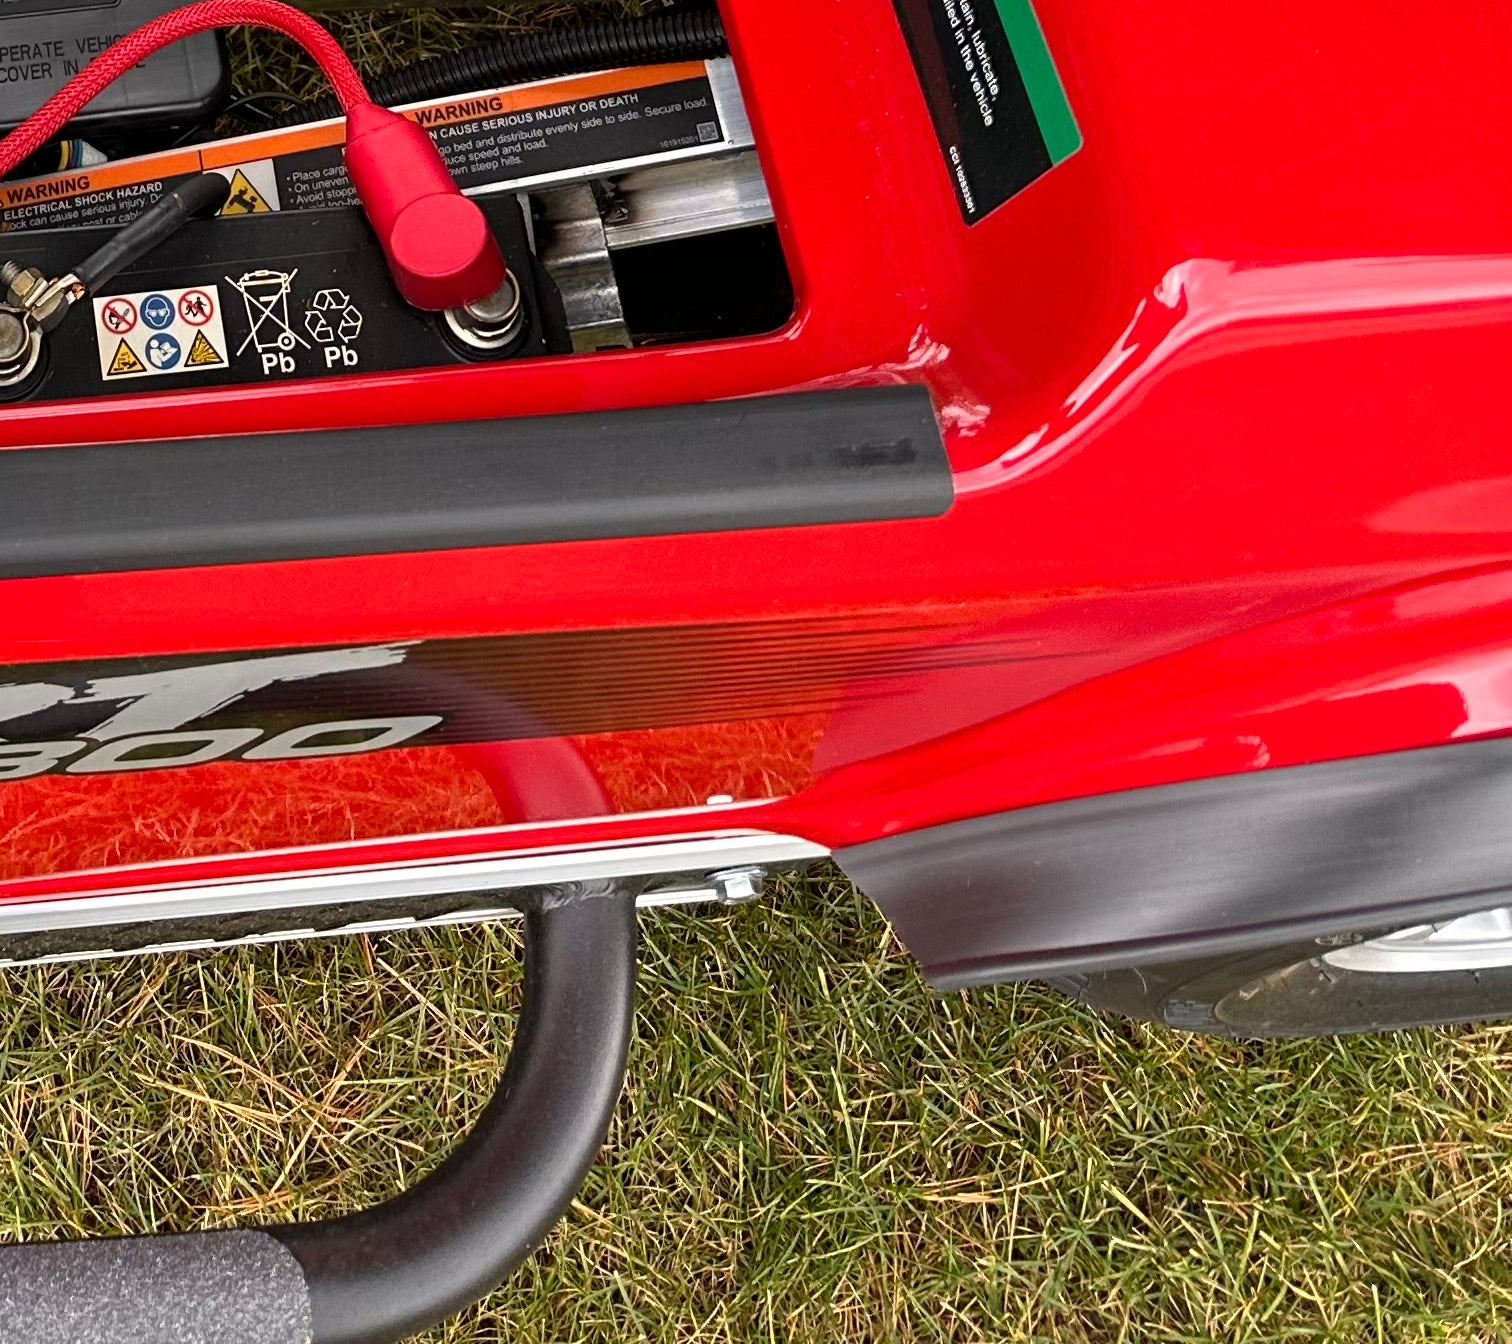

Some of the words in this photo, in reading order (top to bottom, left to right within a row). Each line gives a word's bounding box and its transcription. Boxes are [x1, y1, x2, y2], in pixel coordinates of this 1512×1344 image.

[75, 32, 126, 54] VEHIC
[954, 27, 965, 45] in
[960, 44, 974, 71] the
[970, 72, 993, 127] vehicle
[414, 96, 504, 125] WARNING
[439, 121, 480, 139] CAUSE
[482, 113, 534, 131] SERIOUS
[535, 103, 578, 120] INJURY
[579, 100, 598, 113] OR
[599, 93, 639, 109] DEATH
[292, 169, 321, 182] Place
[453, 139, 473, 152] bed
[475, 135, 495, 148] and
[496, 127, 544, 144] distribute
[545, 120, 579, 136] evenly
[580, 115, 603, 129] side
[604, 114, 616, 124] to
[644, 101, 682, 118] Secure
[949, 145, 960, 165] CCI
[294, 182, 310, 193] On
[467, 147, 500, 163] speed
[501, 142, 522, 155] and
[295, 191, 324, 205] Avoid
[470, 160, 499, 175] steep
[3, 197, 73, 221] ELECTRICAL
[74, 189, 115, 208] SHOCK
[116, 181, 164, 200] HAZARD
[6, 175, 91, 205] WARNING
[29, 215, 48, 227] can
[50, 210, 80, 224] cause
[81, 202, 117, 219] serious
[118, 210, 143, 224] cabl
[261, 352, 296, 376] Pb
[323, 345, 360, 369] Pb
